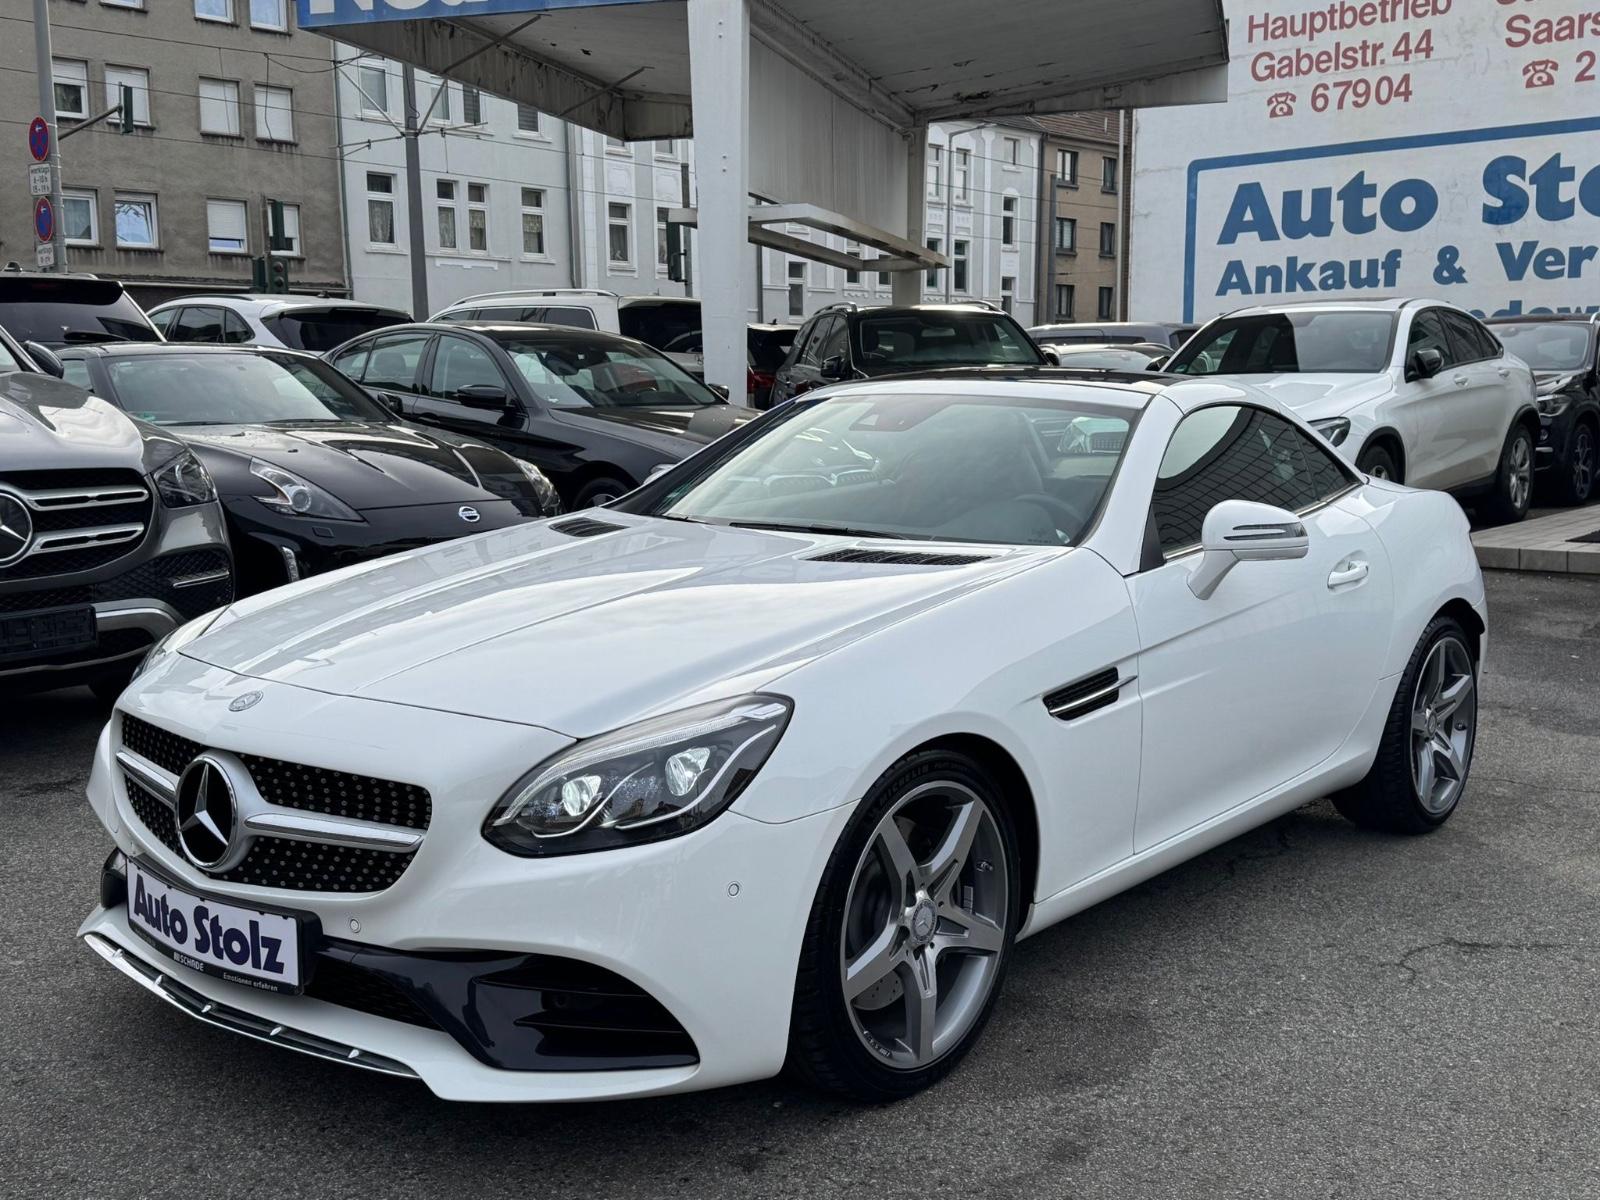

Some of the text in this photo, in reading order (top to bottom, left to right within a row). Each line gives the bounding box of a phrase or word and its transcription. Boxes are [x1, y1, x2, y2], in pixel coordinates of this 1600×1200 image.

[1248, 0, 1452, 43] Hauptbetrieb
[1251, 29, 1434, 82] Gabelstr. 44
[1311, 73, 1413, 113] 67904
[1217, 170, 1439, 245] Auto
[1215, 239, 1599, 297] Ankauf & Ver
[134, 873, 285, 975] Auto Stolz
